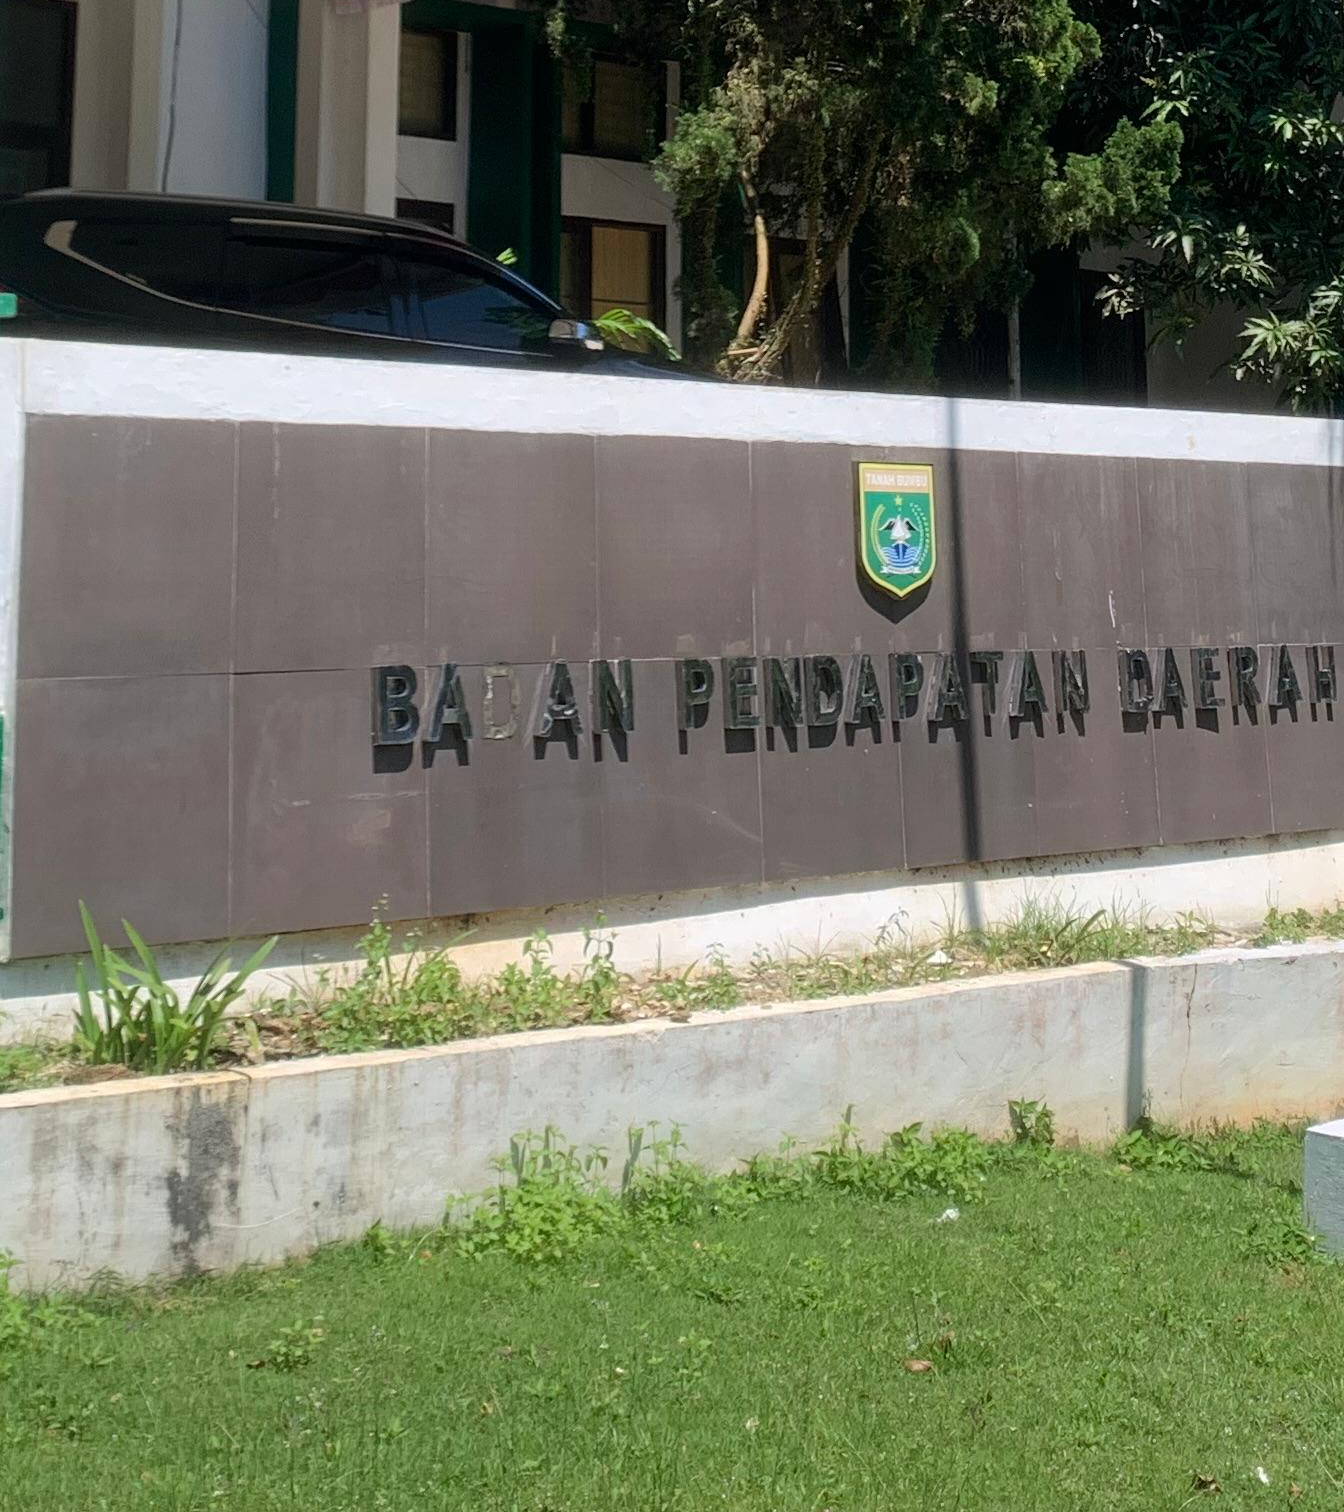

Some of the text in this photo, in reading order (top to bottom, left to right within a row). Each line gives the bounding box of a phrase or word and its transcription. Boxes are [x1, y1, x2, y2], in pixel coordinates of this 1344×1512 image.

[370, 644, 1338, 746] BADAN PENDAPATAN DAERAH
